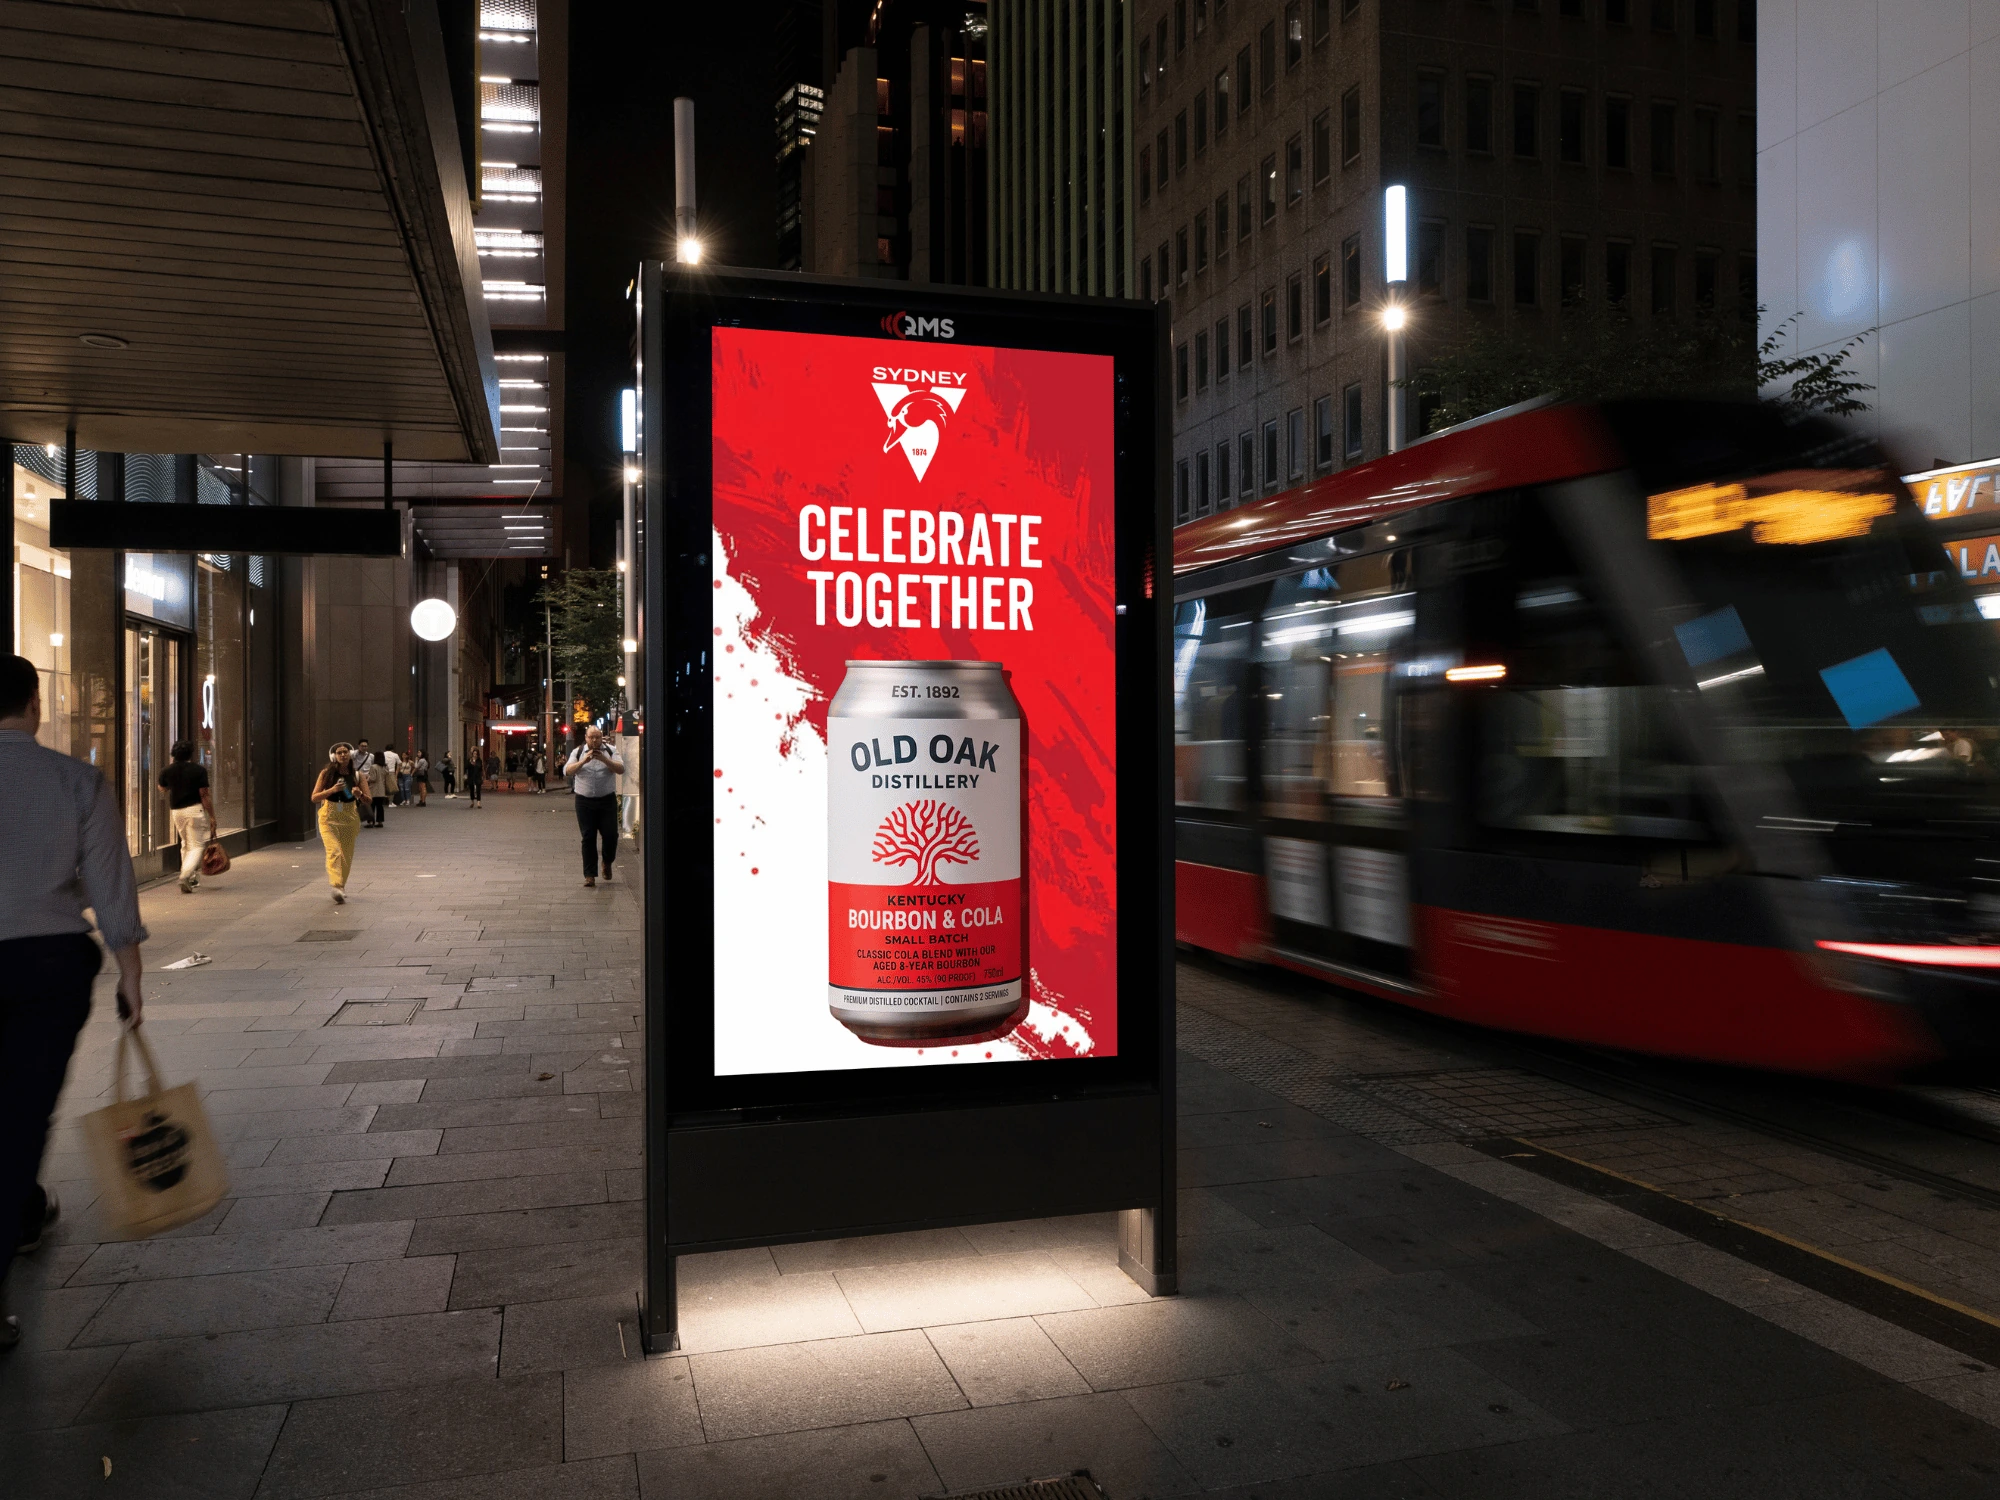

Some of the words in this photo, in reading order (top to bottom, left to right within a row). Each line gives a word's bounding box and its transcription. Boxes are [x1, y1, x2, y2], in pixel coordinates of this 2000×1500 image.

[892, 311, 955, 339] QMS
[872, 366, 967, 386] SYDNEY
[912, 448, 927, 457] 1874
[799, 504, 1043, 569] CELEBRATE
[806, 570, 1034, 631] TOGETHER
[891, 685, 922, 698] EST.
[926, 685, 960, 699] 1892
[850, 735, 918, 772] OLD
[929, 734, 1000, 773] OAK
[872, 774, 979, 789] DISTILLERY
[887, 893, 966, 906] KENTUCKY
[848, 908, 937, 930] BOURBON
[942, 909, 956, 929] &
[961, 905, 1004, 928] COLA
[885, 935, 925, 945] SMALL
[929, 933, 969, 944] BATCH
[857, 949, 892, 959] CLASSIC
[894, 950, 919, 960] COLA
[922, 949, 953, 959] BLEND
[956, 947, 979, 957] WITH
[980, 945, 996, 955] OUR
[873, 961, 897, 971] AGED
[899, 961, 934, 971] 8-YEAR
[937, 958, 980, 970] BOURBON
[916, 975, 933, 984] 45%
[934, 973, 947, 984] (90
[948, 972, 976, 982] PROOF)
[843, 994, 868, 1005] PREMIUM
[869, 996, 902, 1006] DISTILLED
[904, 996, 939, 1006] COCKTAIL
[945, 993, 979, 1004] CONTAINS
[984, 988, 1009, 1000] SERVINGS
